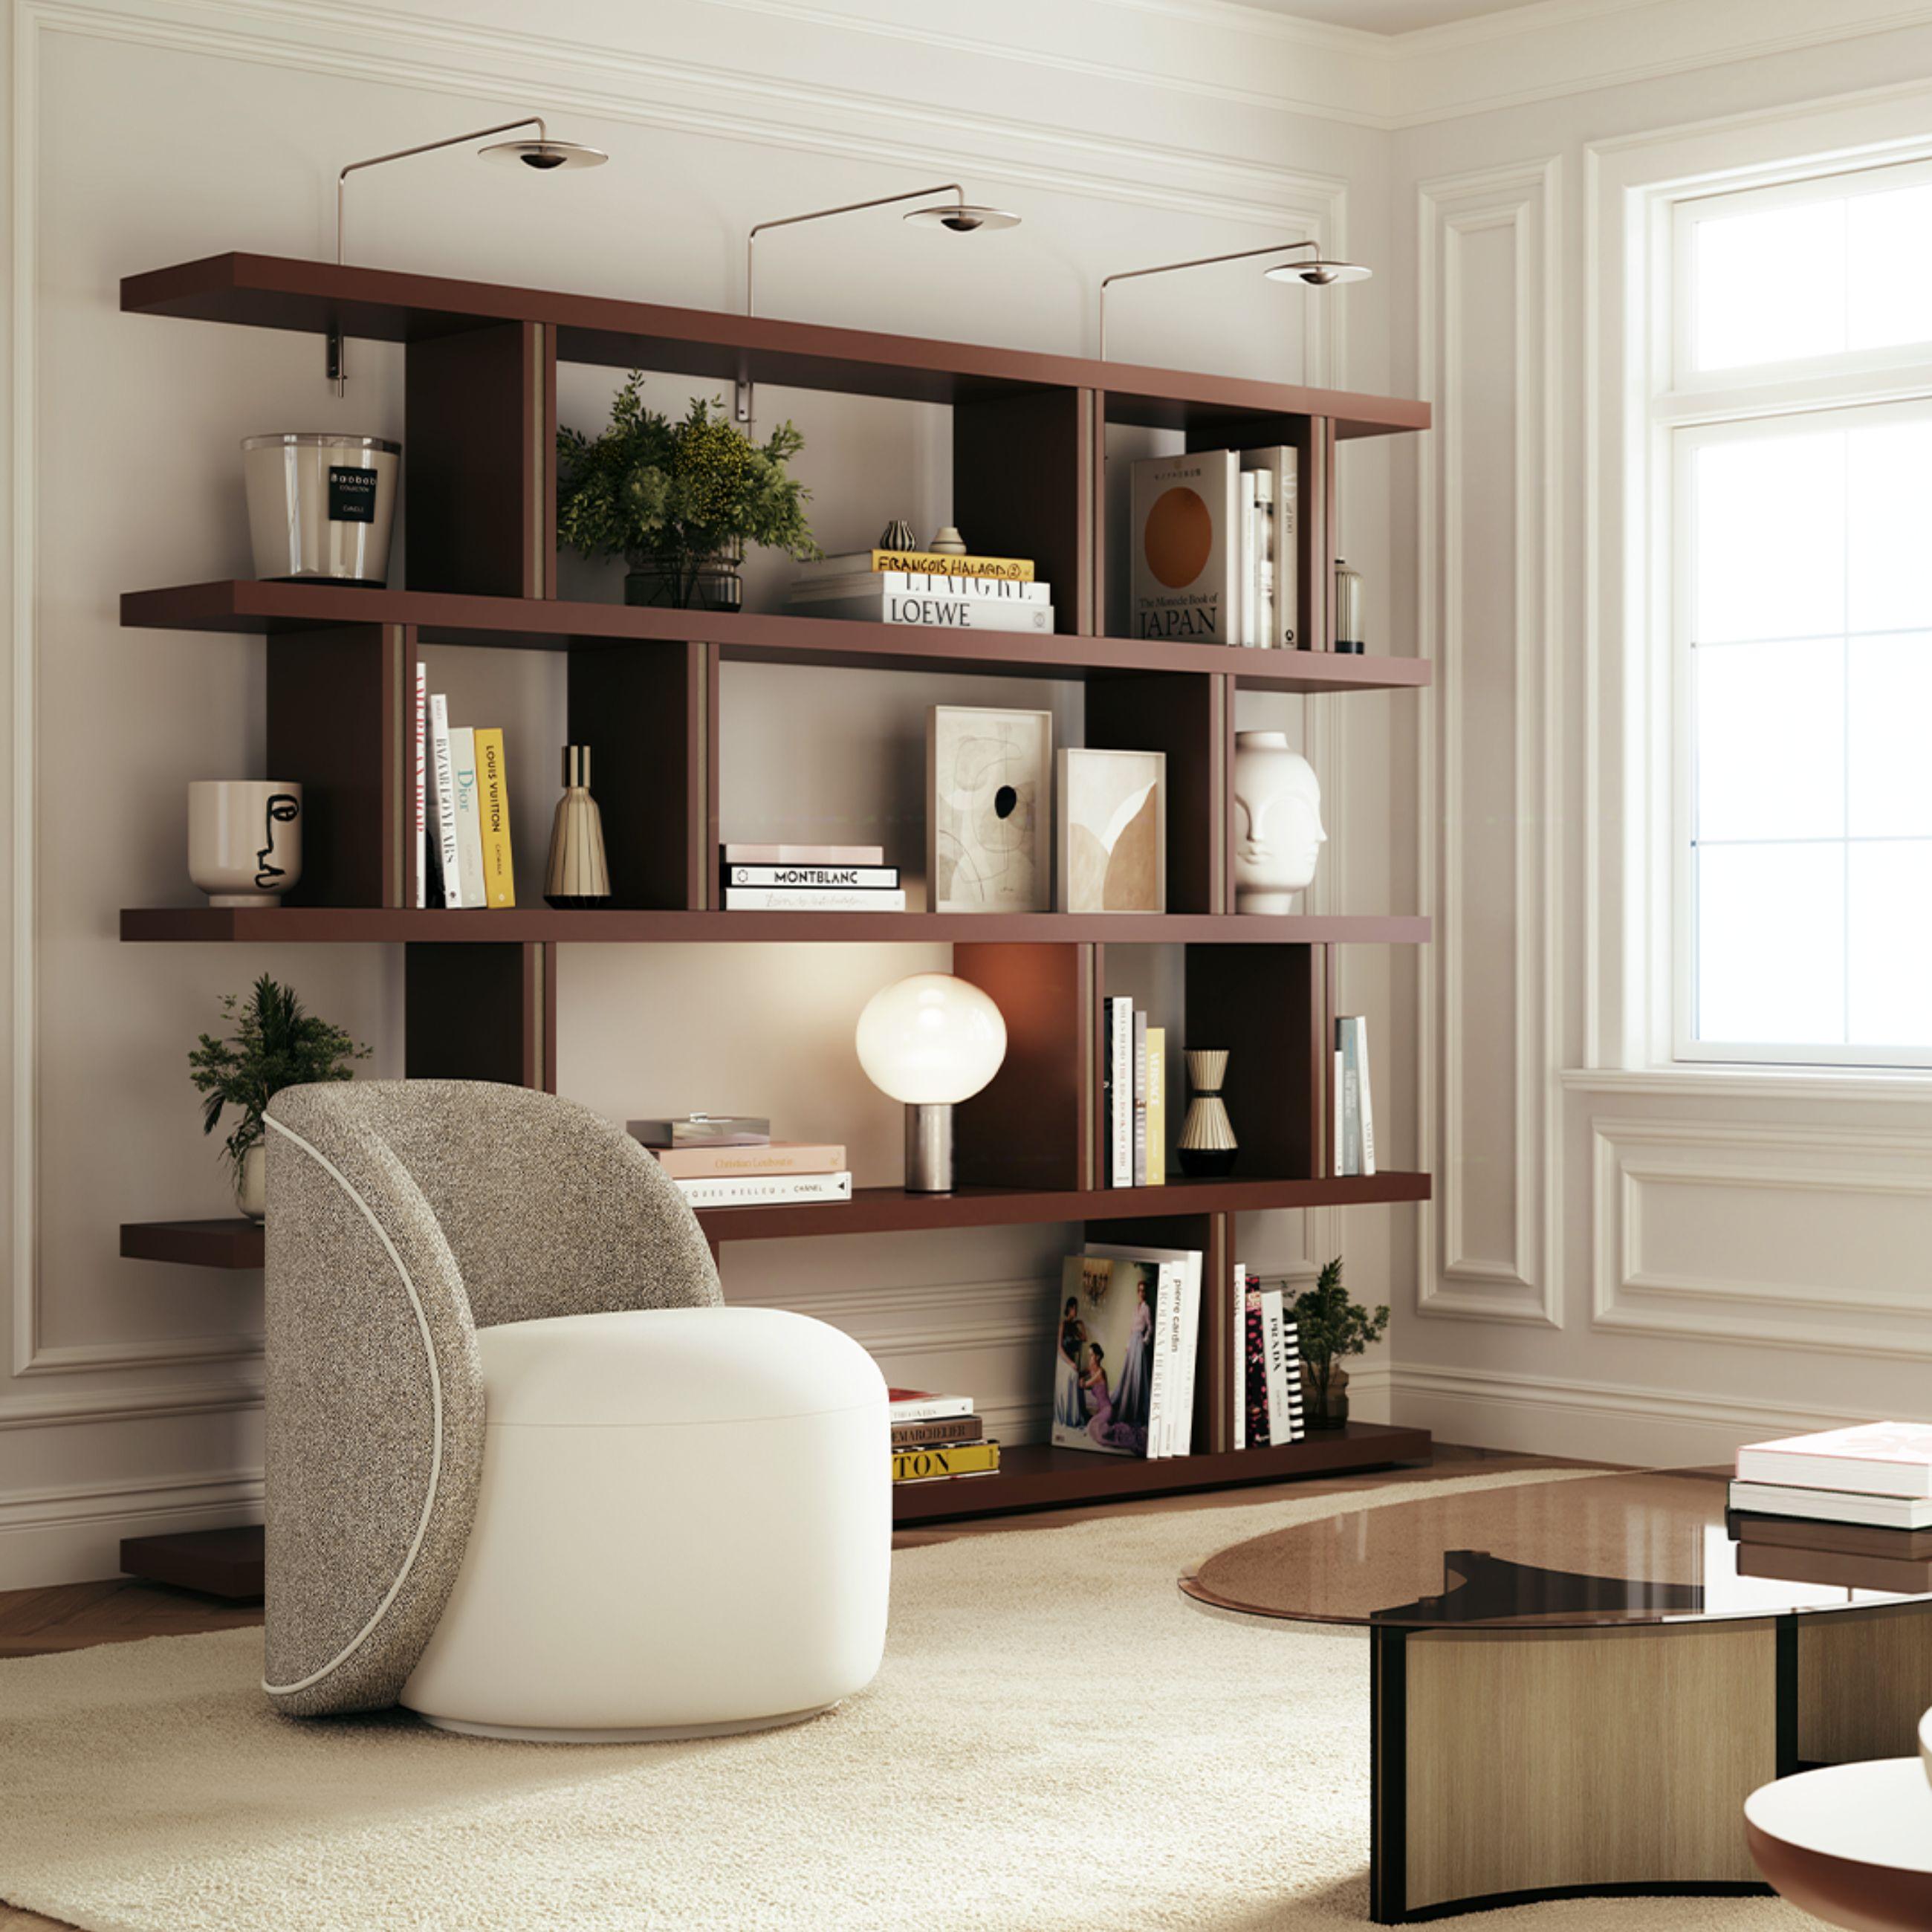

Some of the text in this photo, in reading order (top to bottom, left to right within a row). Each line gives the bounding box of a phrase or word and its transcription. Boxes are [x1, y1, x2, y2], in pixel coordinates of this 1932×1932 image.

[878, 556, 947, 575] FRANÇOIS
[892, 597, 970, 626] LOEWE
[1140, 607, 1217, 639] JAPAN
[458, 770, 474, 812] Dior
[486, 745, 501, 832] LOUIS VUITTON
[774, 870, 858, 884] MONTBLANC
[683, 1189, 723, 1199] CQUES
[1171, 1278, 1182, 1352] pierre cardin
[1270, 1317, 1281, 1372] PRADA
[892, 1425, 965, 1442] EMARCHELIER
[894, 1453, 949, 1477] TON
